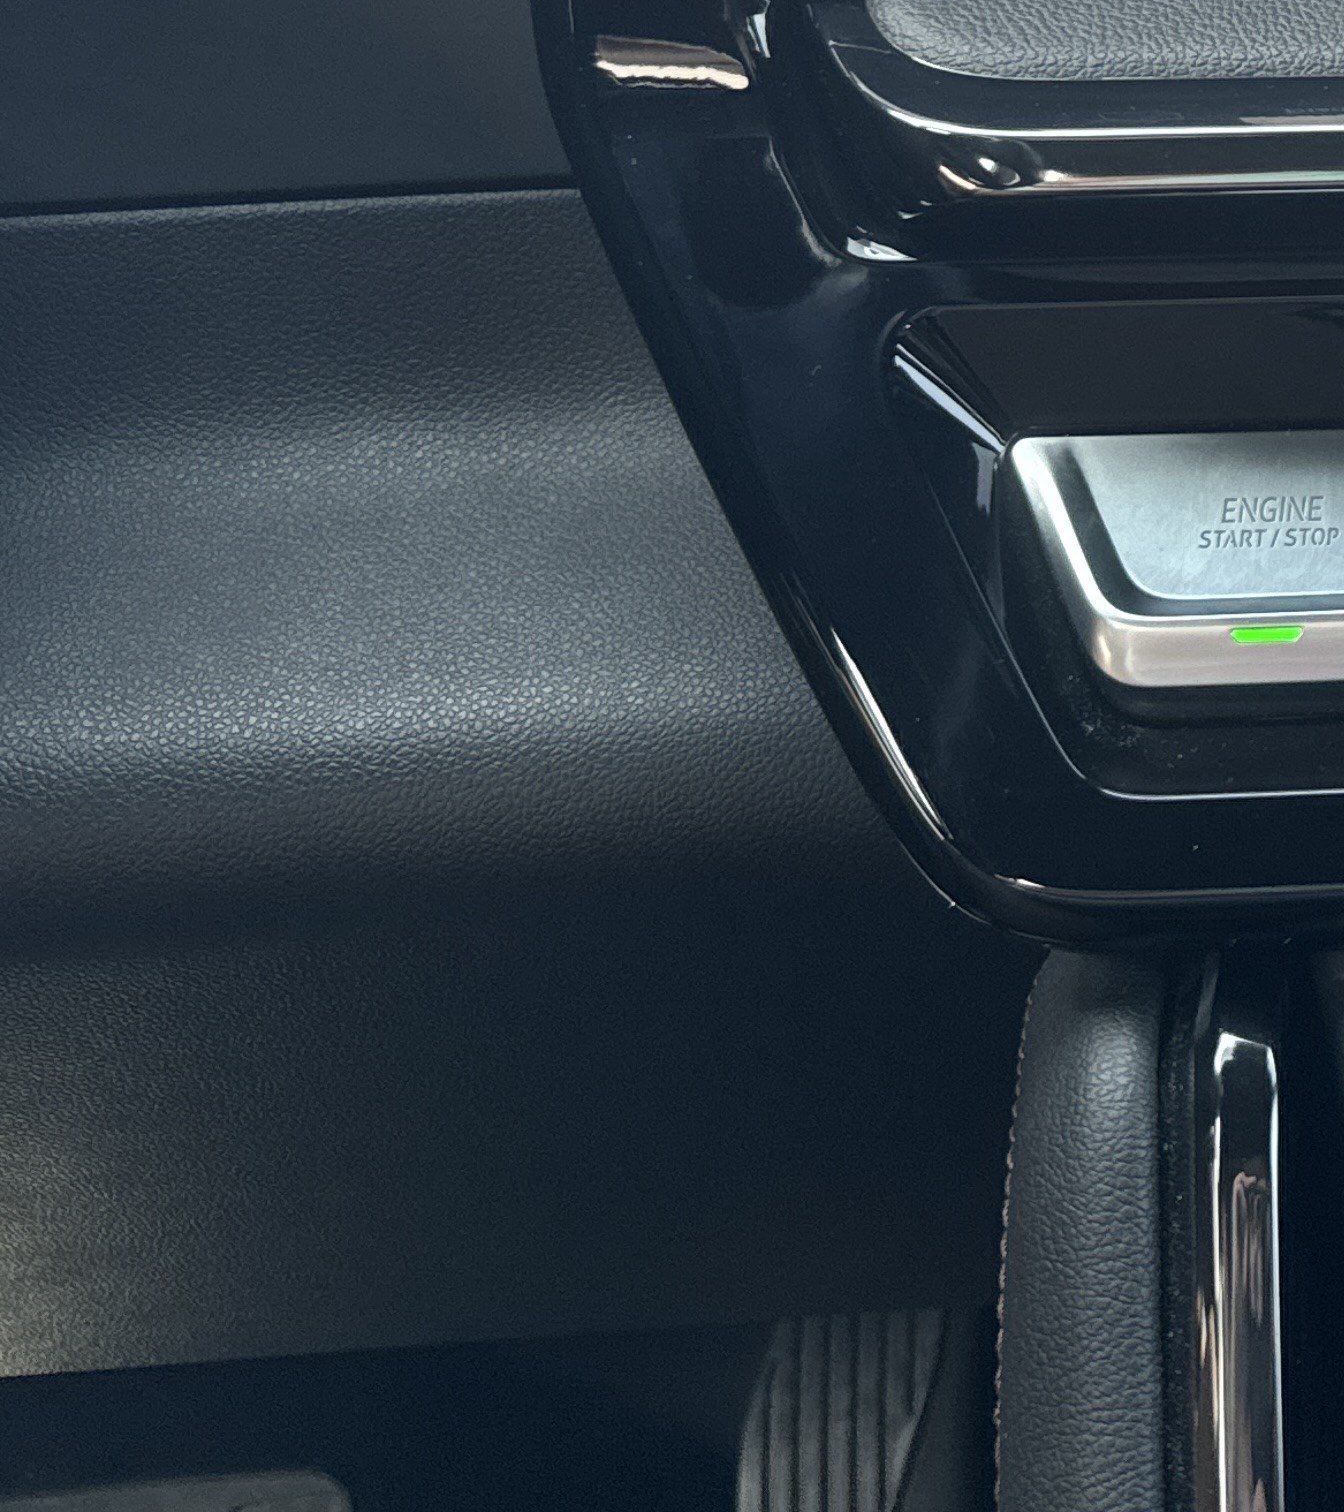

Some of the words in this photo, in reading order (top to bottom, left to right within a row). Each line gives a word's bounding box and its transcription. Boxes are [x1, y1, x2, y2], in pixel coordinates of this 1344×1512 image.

[1220, 495, 1325, 524] ENGINE
[1198, 529, 1267, 549] START
[1284, 527, 1340, 547] STOP
